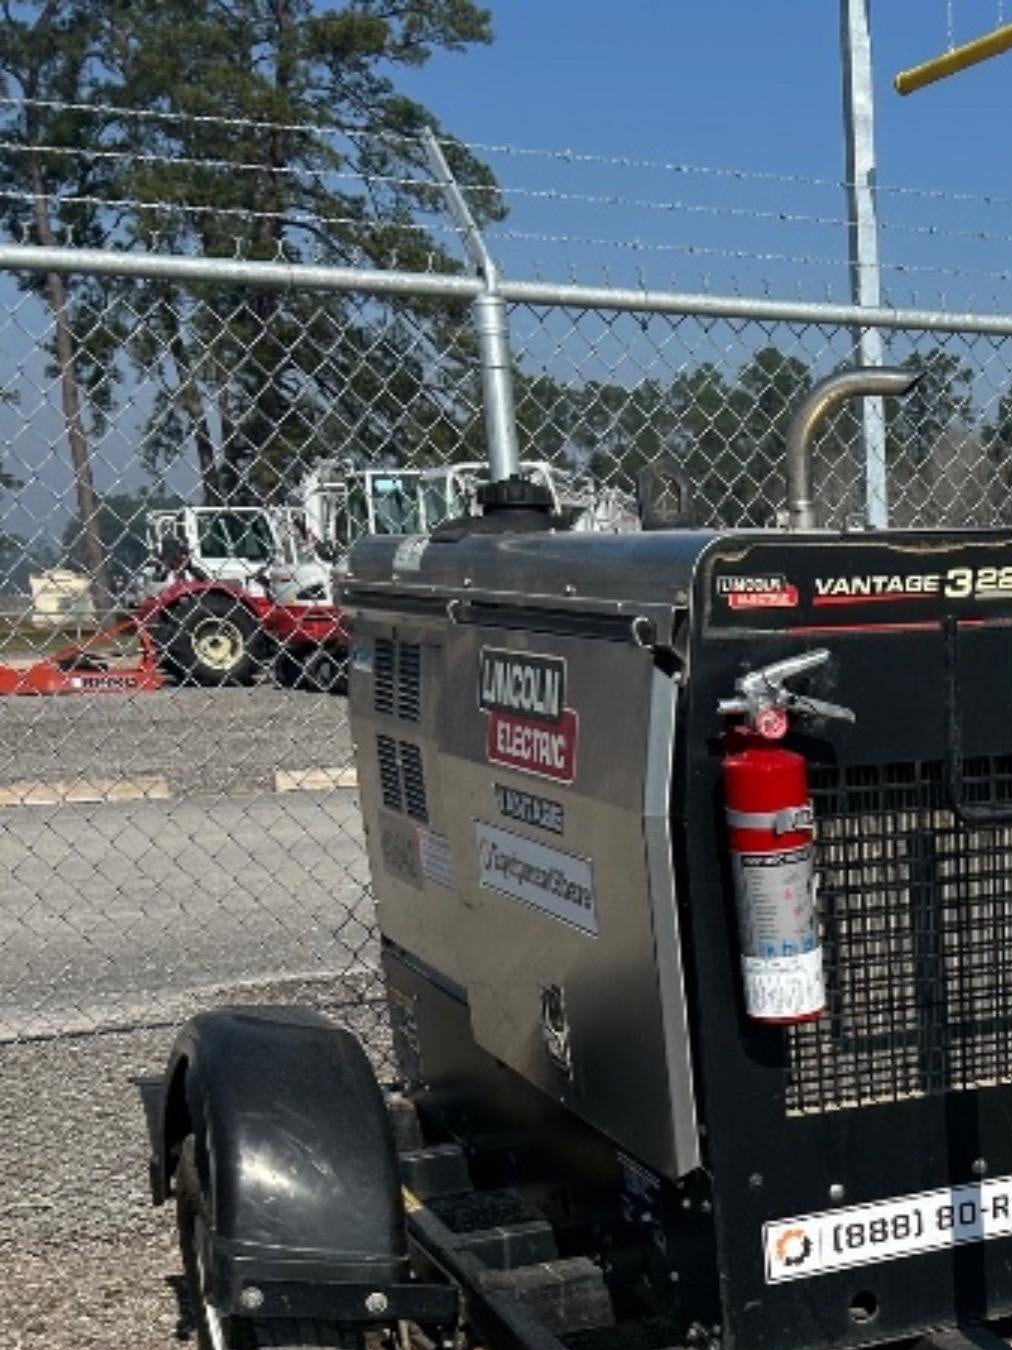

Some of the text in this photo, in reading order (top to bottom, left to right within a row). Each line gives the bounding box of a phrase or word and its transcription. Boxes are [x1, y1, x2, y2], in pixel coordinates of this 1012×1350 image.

[814, 575, 939, 595] VANTAGE
[482, 658, 560, 717] LINCOLN
[497, 719, 566, 769] ELECTRIC
[833, 1209, 924, 1254] (888)
